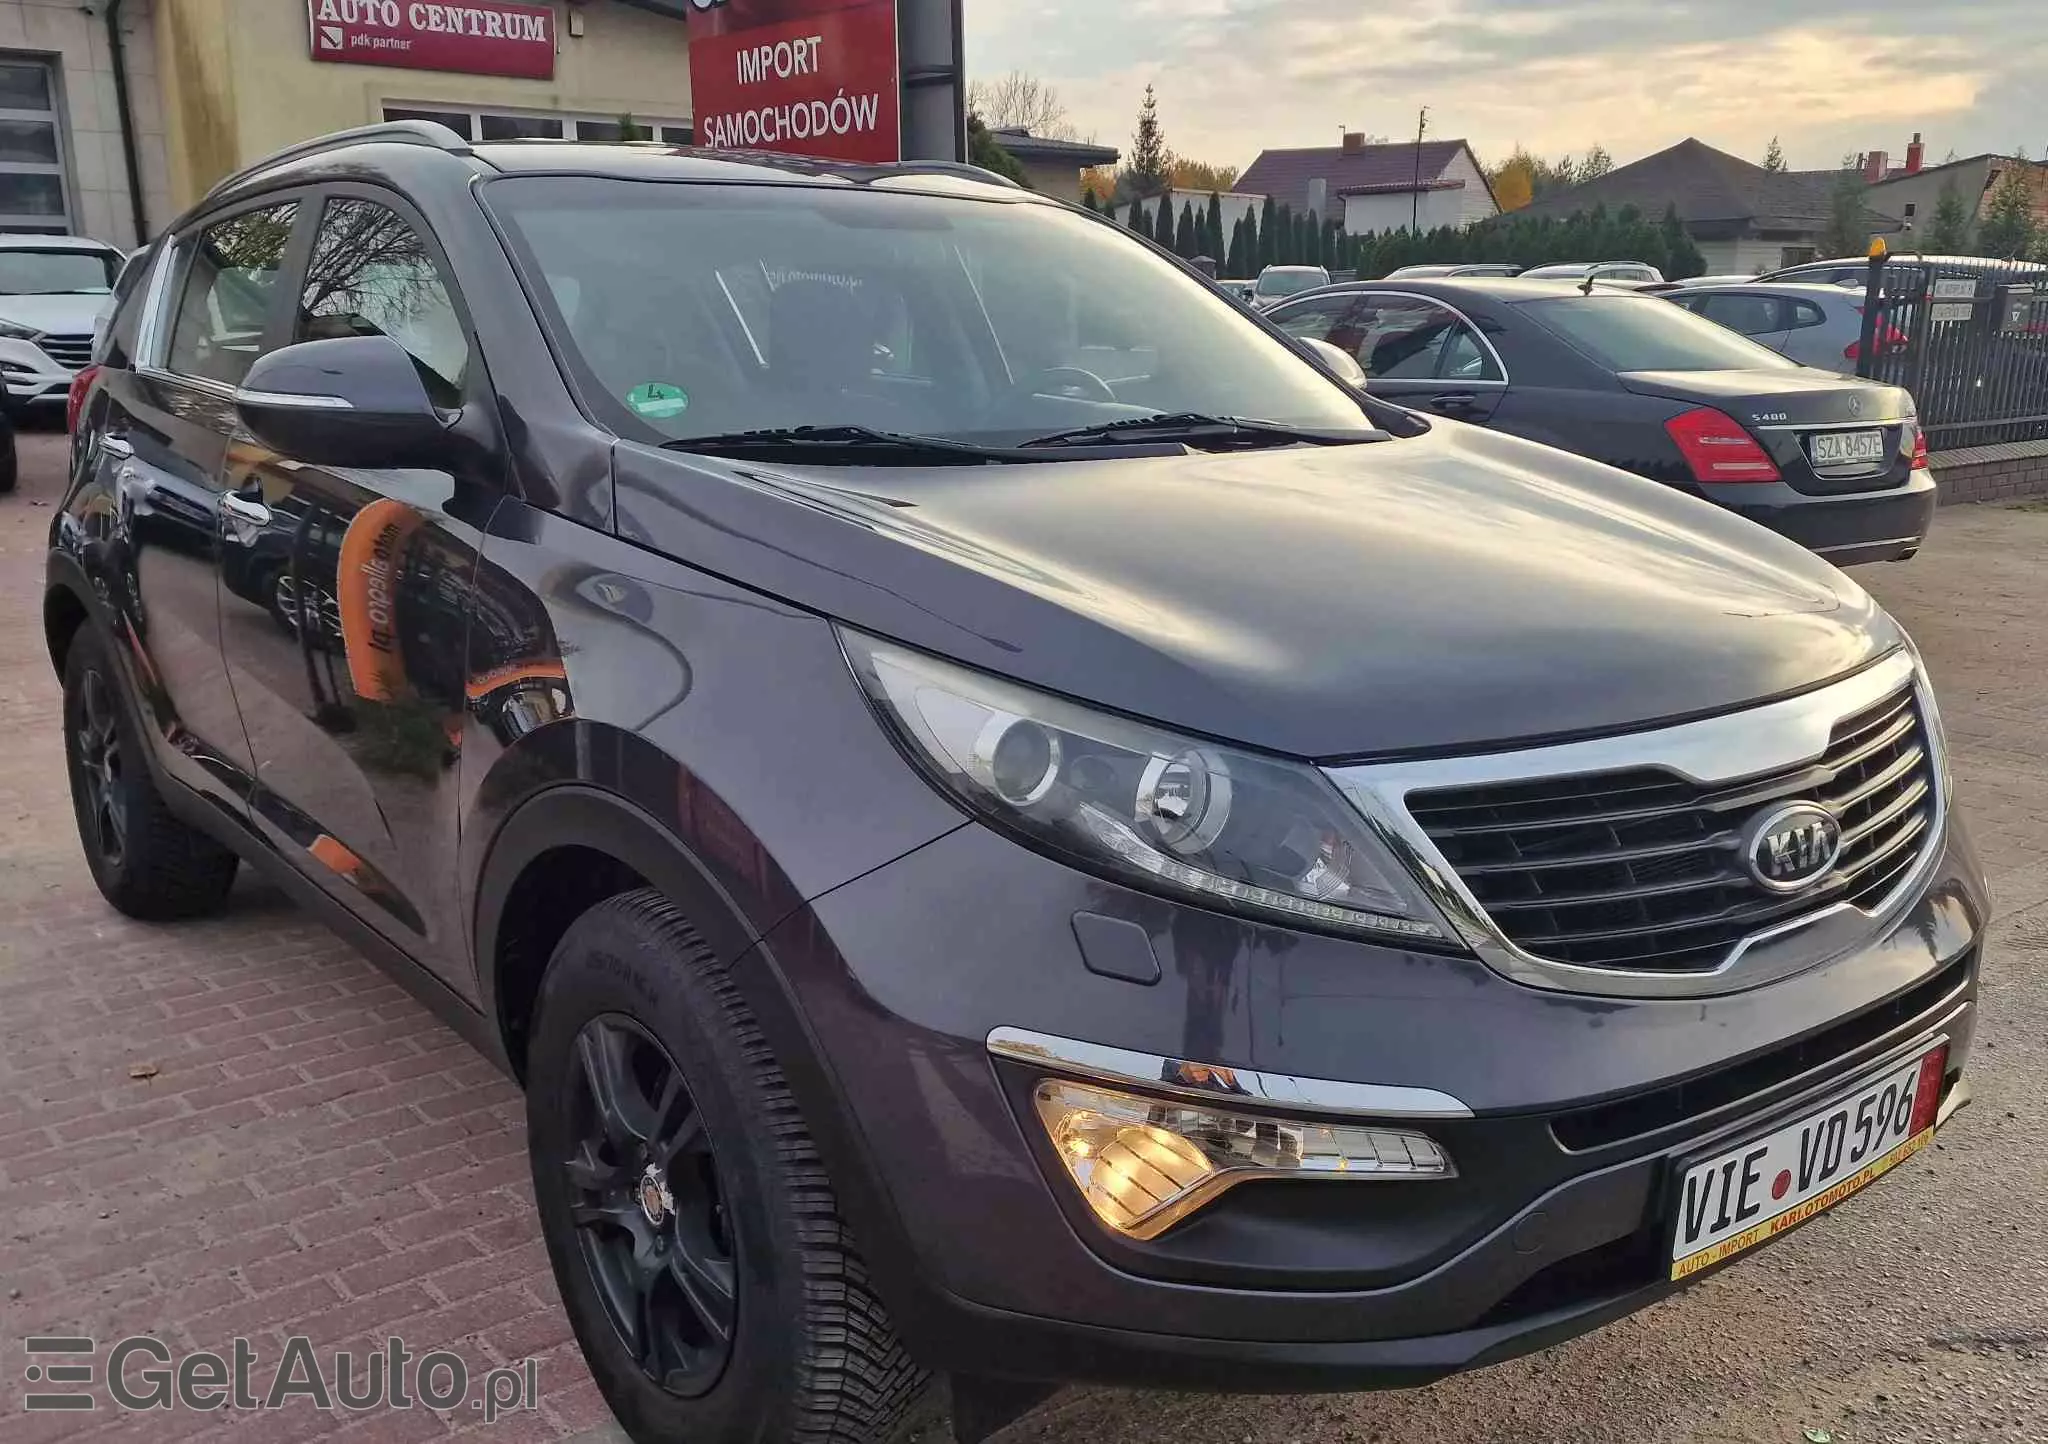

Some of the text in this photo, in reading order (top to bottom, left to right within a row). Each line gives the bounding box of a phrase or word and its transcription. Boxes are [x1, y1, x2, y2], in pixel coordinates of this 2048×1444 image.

[317, 0, 547, 42] AUTO CENTRUM
[351, 34, 411, 50] pdk partner
[736, 36, 822, 85] IMPORT
[703, 88, 879, 149] SAMOCHODÓW
[1767, 822, 1831, 876] KIA
[1685, 1146, 1768, 1244] VIE
[1679, 1252, 1709, 1275] AUTO
[1719, 1229, 1760, 1257] IMPORT
